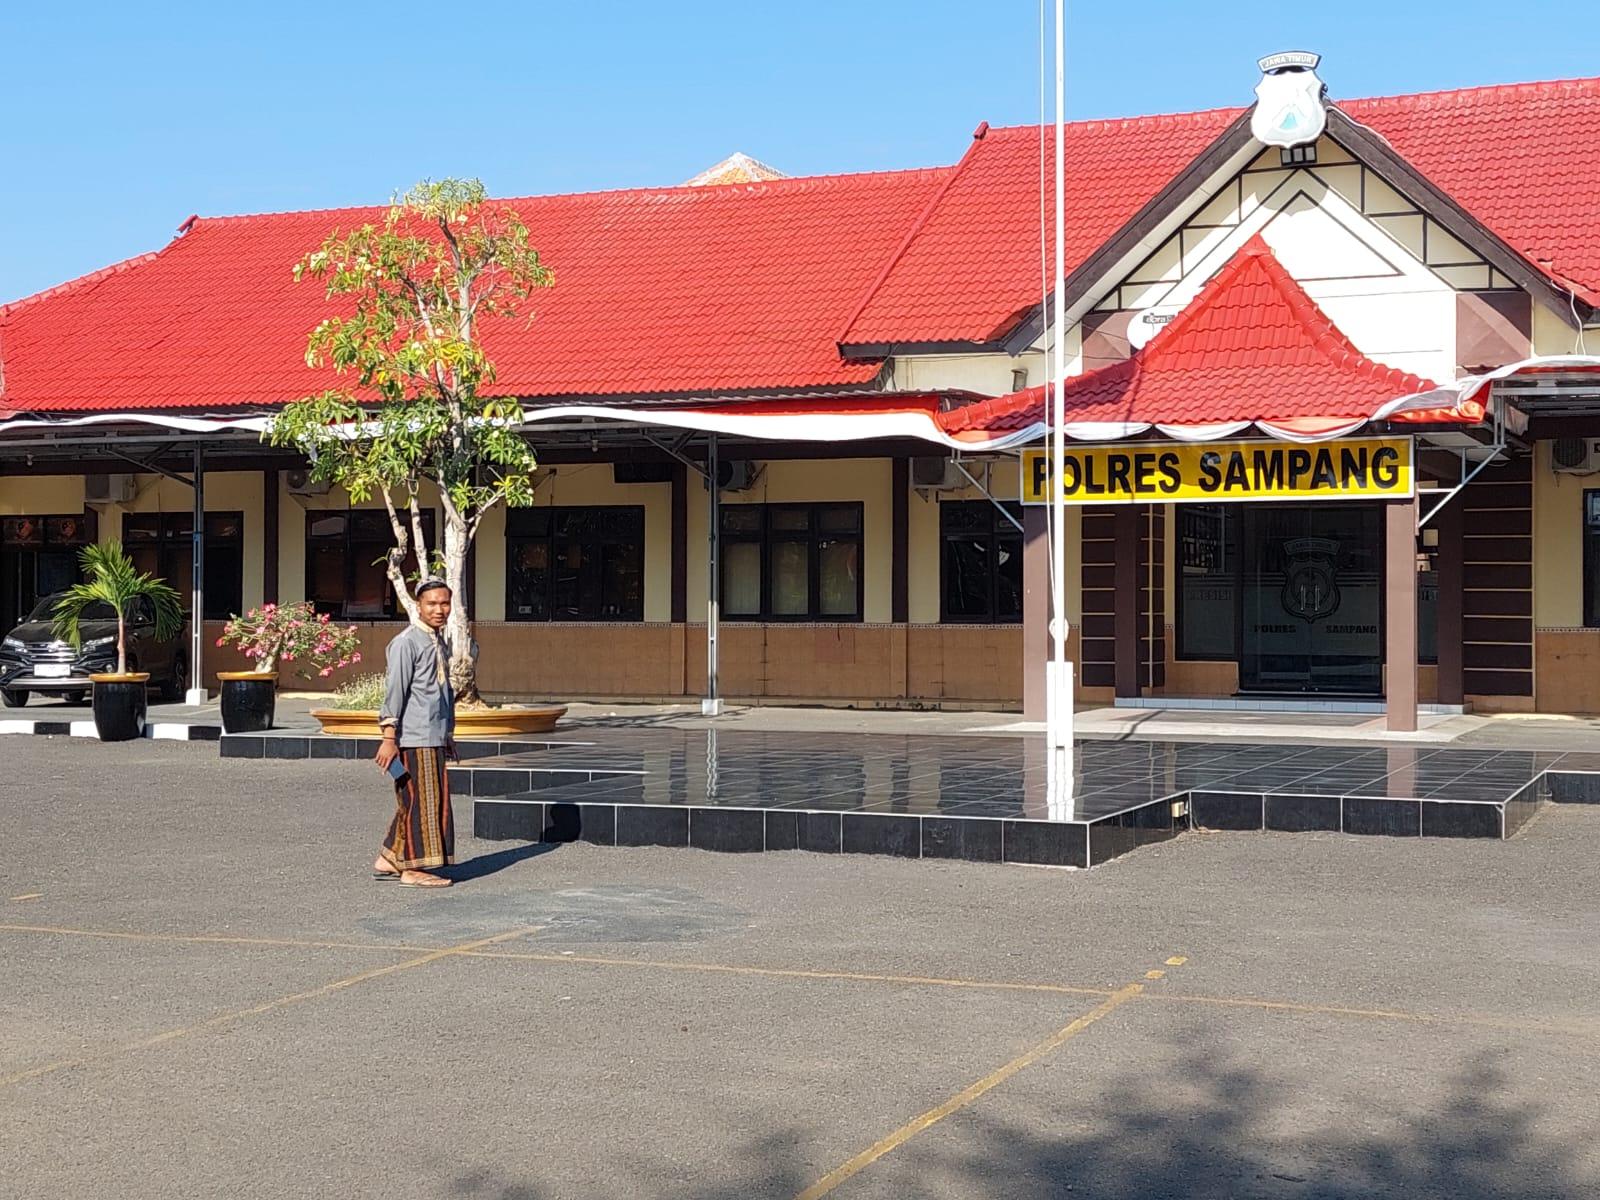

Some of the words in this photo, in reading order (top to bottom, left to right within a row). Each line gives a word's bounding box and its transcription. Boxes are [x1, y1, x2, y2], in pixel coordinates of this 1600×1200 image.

[1265, 56, 1286, 67] JAWA
[1288, 55, 1312, 64] TIMUR
[1032, 452, 1181, 496] POLRES
[1198, 446, 1400, 493] SAMPANG
[1254, 624, 1296, 633] POLRES
[1326, 624, 1377, 633] SAMPANG
